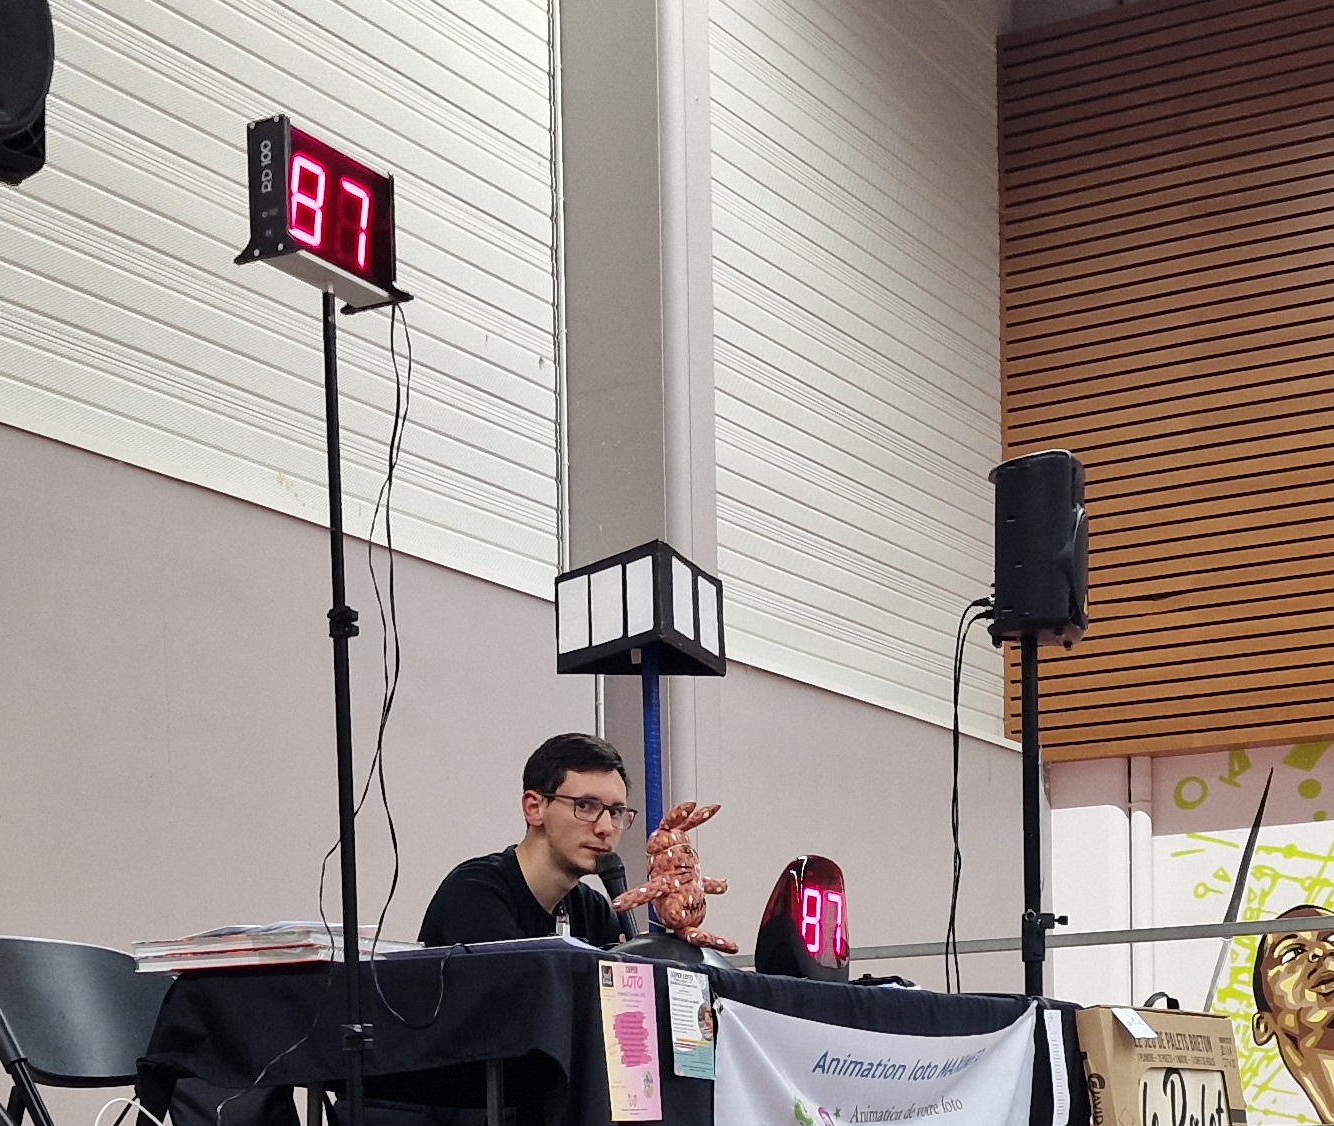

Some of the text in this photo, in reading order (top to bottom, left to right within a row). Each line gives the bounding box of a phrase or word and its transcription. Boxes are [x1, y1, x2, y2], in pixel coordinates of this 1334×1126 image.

[260, 140, 273, 194] RD 100
[288, 155, 370, 269] 87
[801, 887, 842, 956] 87
[622, 975, 644, 990] LOTO
[1165, 1031, 1190, 1052] PALETS
[1188, 1033, 1214, 1053] BRETON
[812, 1050, 907, 1081] Animation
[908, 1058, 939, 1082] loto
[940, 1095, 964, 1114] loto
